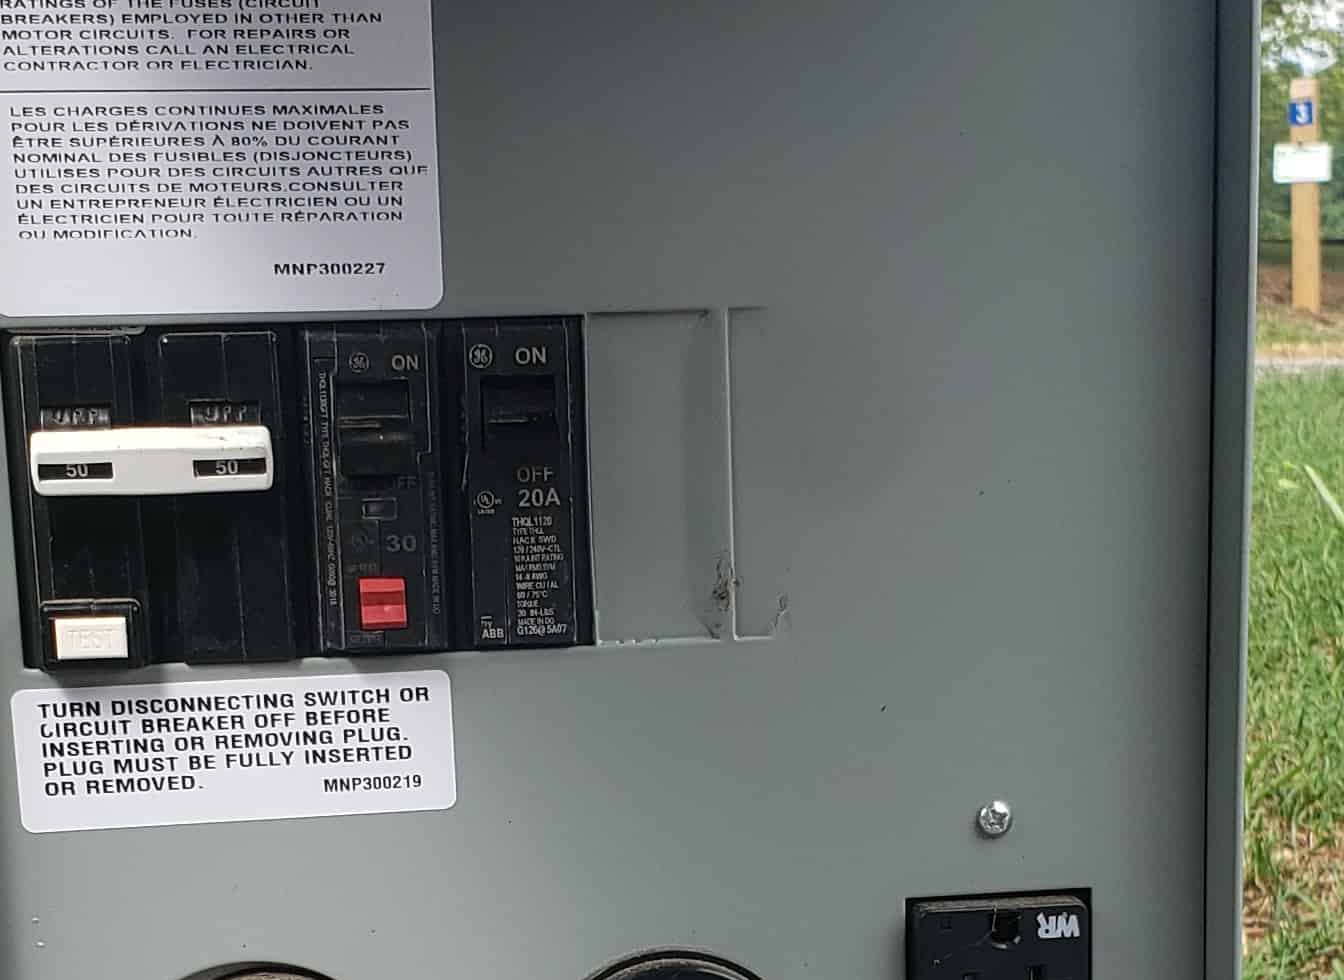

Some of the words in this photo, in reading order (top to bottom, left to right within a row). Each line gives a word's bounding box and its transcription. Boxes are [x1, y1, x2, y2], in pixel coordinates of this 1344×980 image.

[0, 0, 86, 9] RATINGS
[128, 0, 162, 8] THE
[169, 0, 232, 8] FUSES
[238, 0, 319, 9] (CIRCUIT
[1, 14, 114, 25] BREAKERS)
[121, 13, 228, 24] EMPLOYED
[234, 13, 255, 24] IN
[259, 13, 324, 24] OTHER
[332, 13, 382, 24] THAN
[2, 29, 72, 40] MOTOR
[79, 29, 174, 40] CIRCUITS.
[187, 29, 227, 40] FOR
[233, 28, 316, 40] REPAIRS
[323, 28, 350, 39] OR
[3, 45, 139, 56] ALTERATIONS
[145, 44, 196, 55] CALL
[202, 44, 229, 55] AN
[235, 42, 354, 55] ELECTRICAL
[3, 60, 139, 71] CONTRACTOR
[146, 60, 173, 70] OR
[180, 59, 312, 70] ELECTRICIAN.
[10, 106, 47, 117] LES
[53, 106, 148, 117] CHARGES
[154, 105, 266, 116] CONTINUES
[272, 104, 384, 115] MAXIMALES
[1295, 103, 1309, 123] 3
[11, 122, 65, 132] POUR
[72, 121, 108, 132] LES
[115, 121, 245, 132] DÉRIVATIONS
[251, 120, 277, 131] NE
[283, 120, 366, 131] DOIVENT
[372, 120, 409, 130] PAS
[12, 135, 63, 148] ÊTRE
[69, 136, 205, 148] SUPÉRIEURES
[212, 134, 225, 147] À
[231, 136, 268, 147] 80%
[275, 135, 300, 146] DU
[307, 134, 400, 146] COURANT
[13, 153, 102, 163] NOMINAL
[109, 152, 147, 163] DES
[153, 151, 247, 162] FUSIBLES
[253, 150, 412, 161] (DISJONCTEURS)
[14, 168, 100, 179] UTILISES
[107, 167, 161, 178] POUR
[168, 167, 206, 177] DES
[212, 166, 301, 177] CIRCUITS
[307, 166, 383, 176] AUTRES
[389, 165, 428, 175] QUE
[16, 184, 54, 194] DES
[60, 183, 150, 194] CIRCUITS
[157, 183, 182, 193] DE
[189, 181, 403, 192] MOTEURS.CONSULTER
[17, 199, 42, 210] UN
[50, 198, 206, 209] ENTREPRENEUR
[213, 196, 337, 208] ÉLECTRICIEN
[344, 196, 370, 207] OU
[377, 195, 402, 207] UN
[18, 213, 144, 225] ÉLECTRICIEN
[151, 213, 204, 224] POUR
[211, 212, 274, 223] TOUTE
[281, 211, 402, 222] RÉPARATION
[19, 230, 46, 240] OU
[53, 229, 197, 239] MODIFICATION.
[274, 263, 385, 275] MNP300227
[391, 353, 420, 371] ON
[515, 346, 547, 365] ON
[65, 463, 89, 478] 50
[216, 460, 239, 475] 50
[517, 466, 554, 483] OFF
[518, 487, 561, 508] 20A
[386, 535, 417, 552] 30
[481, 627, 505, 639] ABB
[37, 701, 101, 718] TURN
[111, 694, 295, 717] DISCONNECTING
[304, 689, 390, 707] SWITCH
[400, 687, 429, 702] OR
[40, 720, 132, 738] CIRCUIT
[141, 715, 245, 734] BREAKER
[254, 712, 295, 728] OFF
[305, 708, 390, 726] BEFORE
[42, 738, 165, 757] INSERTING
[174, 736, 205, 751] OR
[215, 730, 334, 751] REMOVING
[343, 727, 408, 743] PLUG.
[43, 760, 104, 777] PLUG
[113, 757, 179, 774] MUST
[189, 755, 216, 770] BE
[225, 751, 294, 767] FULLY
[305, 745, 412, 764] INSERTED
[45, 781, 76, 796] OR
[86, 775, 203, 794] REMOVED.
[323, 775, 421, 792] MNP300219
[1036, 911, 1082, 939] WR
